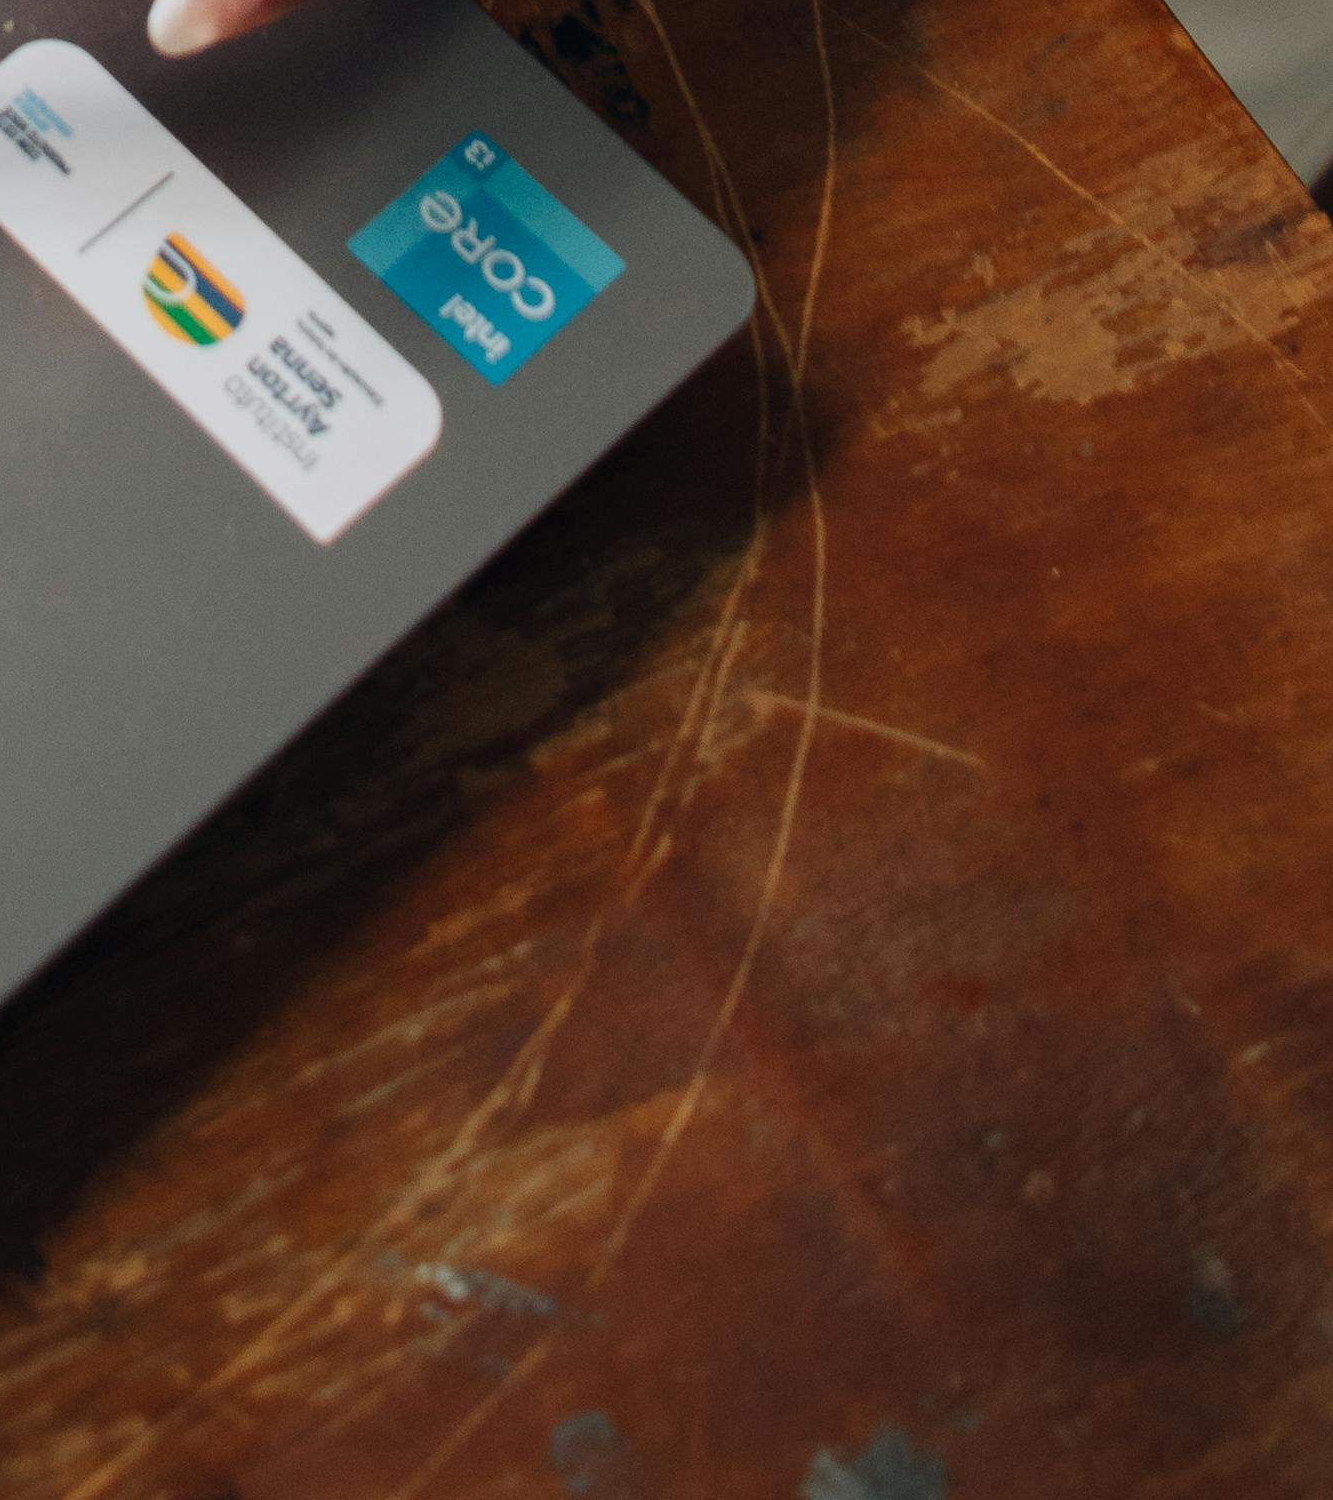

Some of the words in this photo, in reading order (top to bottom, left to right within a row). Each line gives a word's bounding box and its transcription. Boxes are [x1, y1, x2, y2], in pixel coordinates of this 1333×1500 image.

[462, 138, 496, 170] i3
[439, 294, 511, 362] intel
[246, 357, 329, 437] Ayrton
[268, 338, 341, 409] Senna
[222, 376, 318, 471] Instituto
